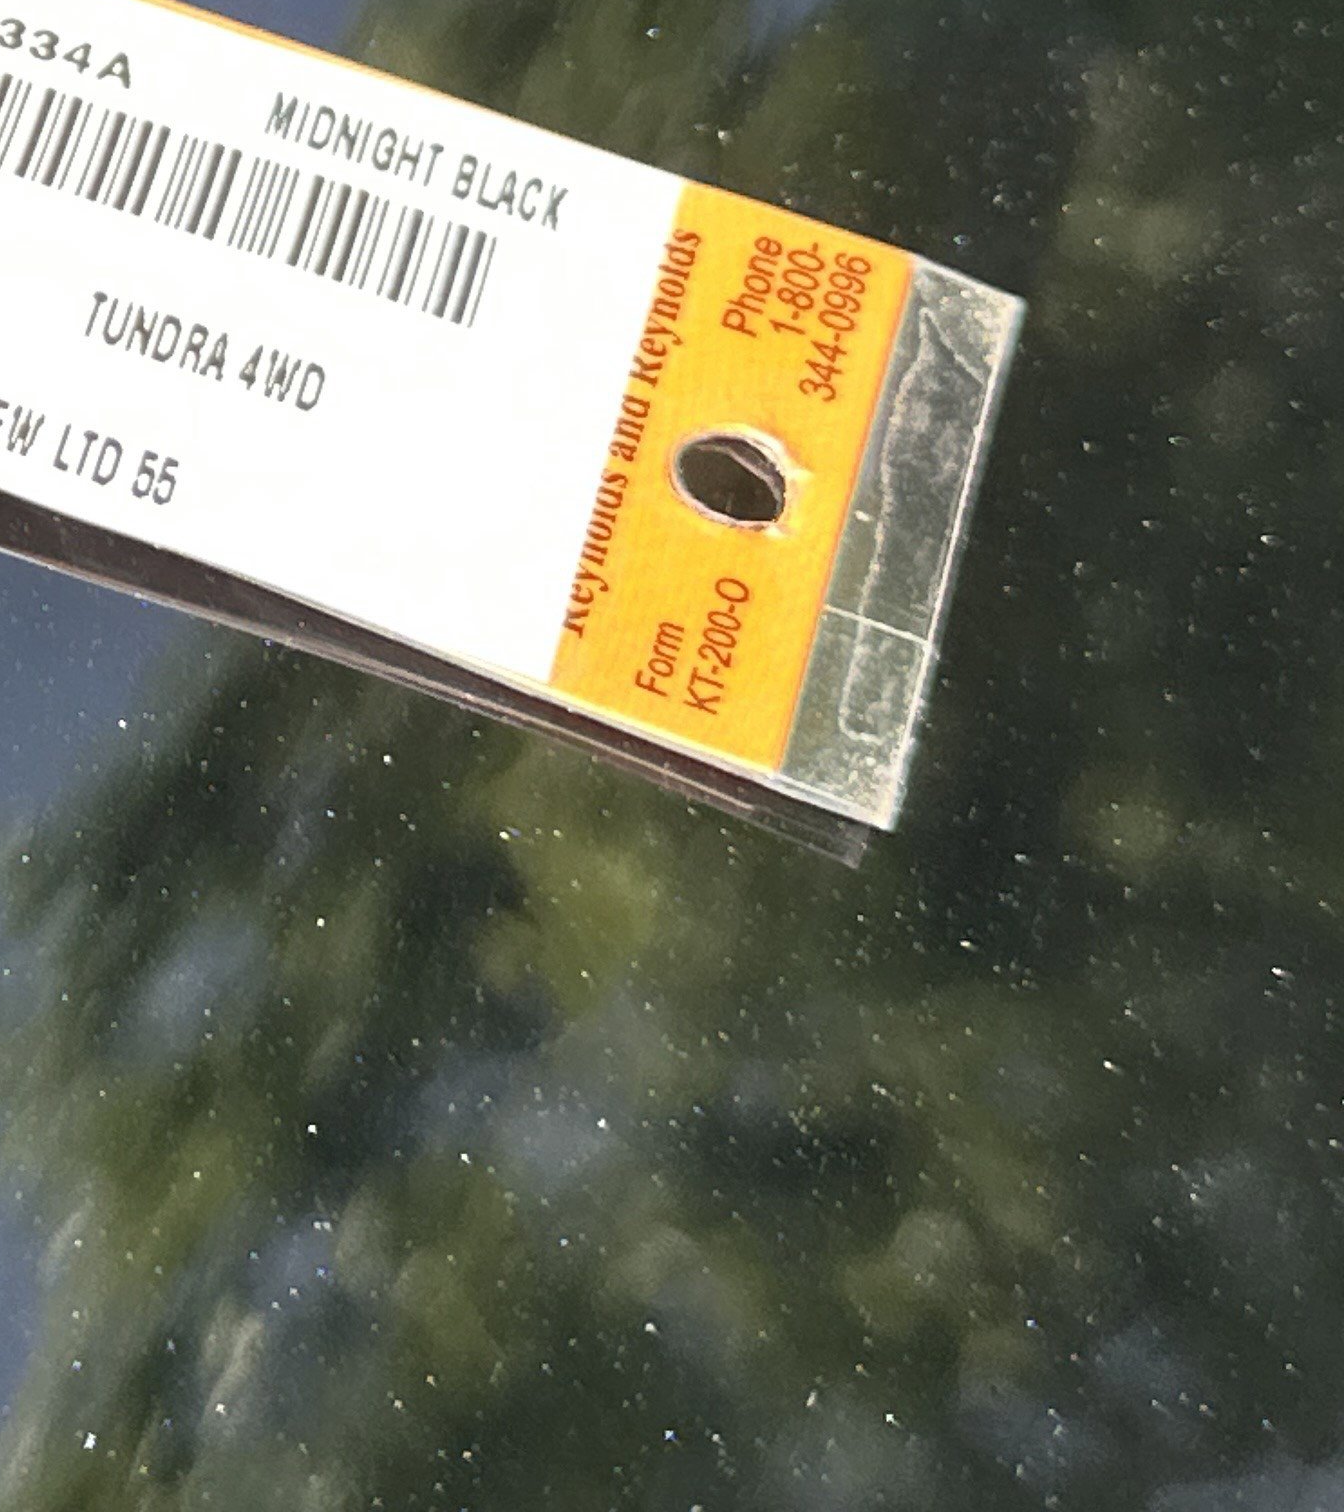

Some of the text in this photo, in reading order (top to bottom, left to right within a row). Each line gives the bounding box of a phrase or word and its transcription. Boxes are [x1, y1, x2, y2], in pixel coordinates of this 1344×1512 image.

[265, 92, 569, 230] MIDNIGHT BLACK
[628, 227, 702, 388] Reynolds
[722, 236, 783, 338] Phone
[770, 242, 821, 335] 1-800-
[799, 253, 872, 402] 344-0996
[85, 292, 327, 413] TUNDRA 4WD
[53, 424, 123, 485] LTD
[132, 450, 179, 505] 55
[609, 395, 650, 462] and
[635, 621, 684, 696] Form
